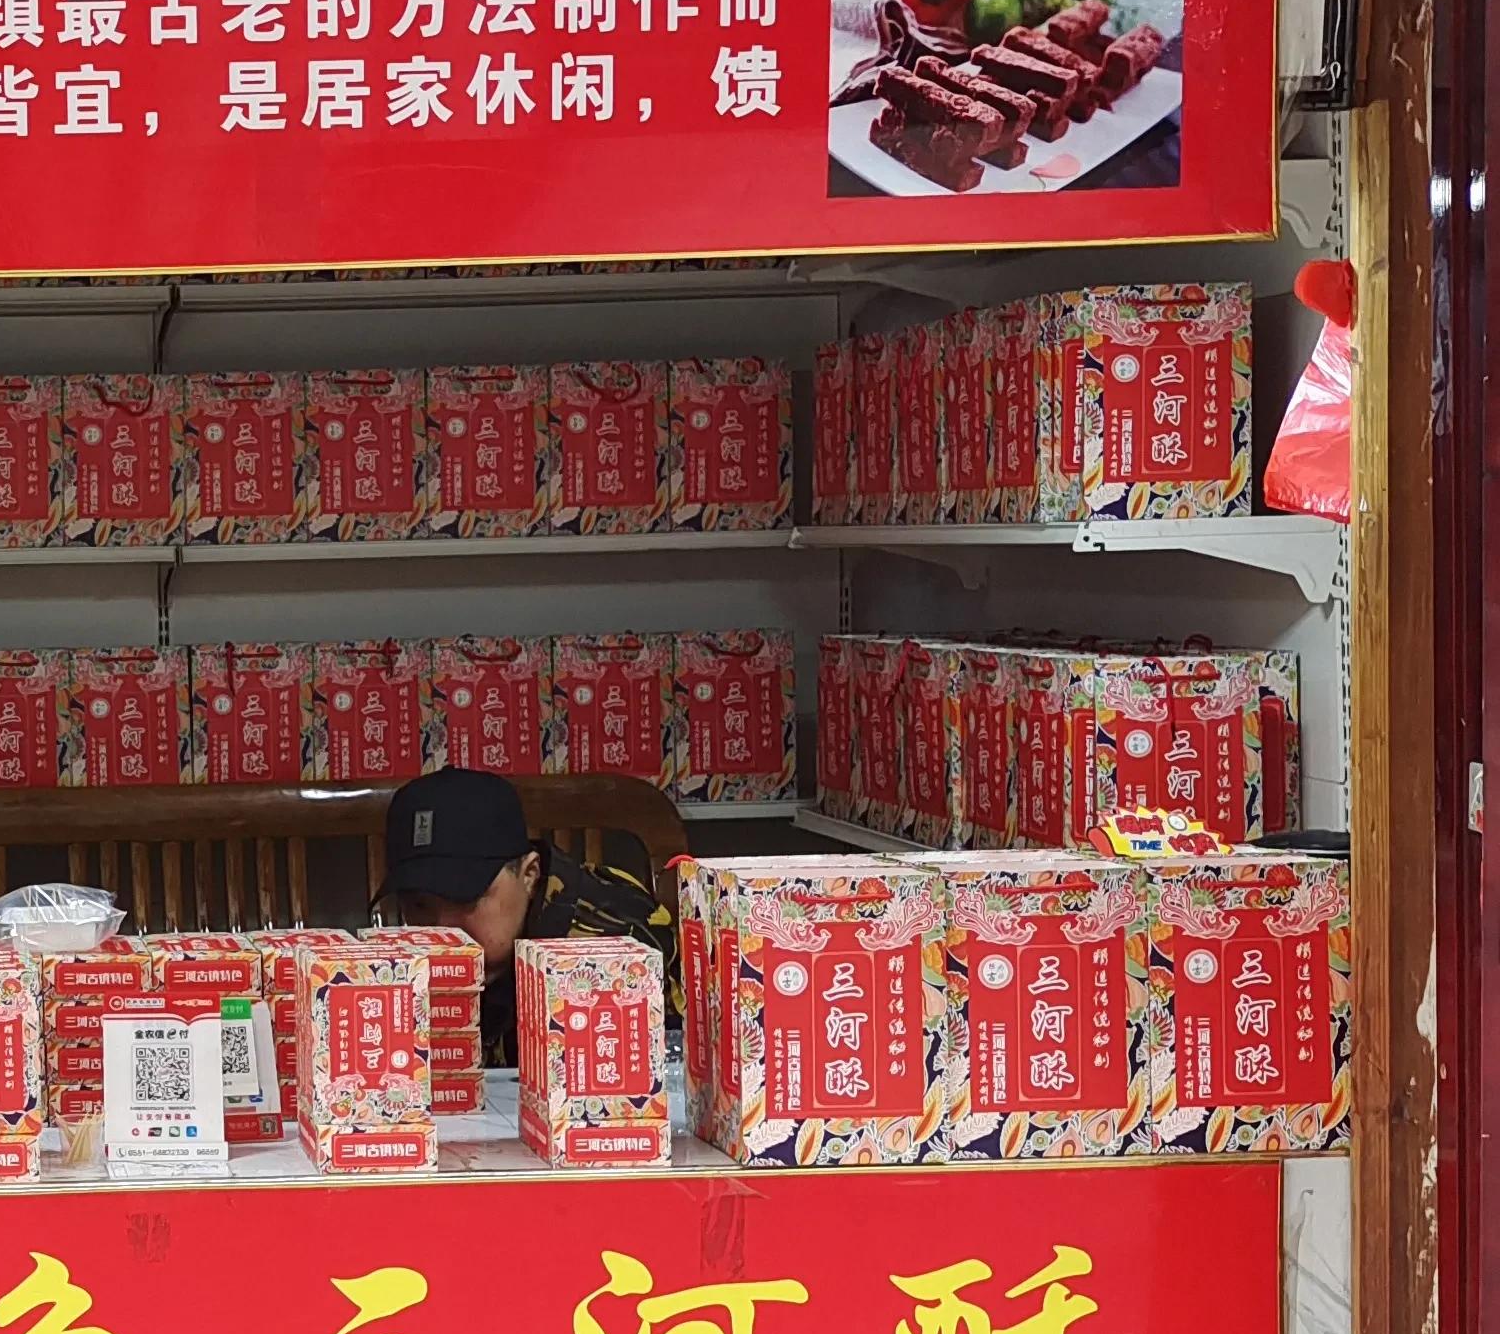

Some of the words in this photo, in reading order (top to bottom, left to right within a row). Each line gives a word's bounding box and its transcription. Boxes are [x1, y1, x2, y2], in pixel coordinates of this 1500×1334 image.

[1151, 355, 1187, 465] 三河酥
[1165, 730, 1199, 820] 三河
[823, 963, 869, 1097] 三河酥
[1028, 956, 1074, 1090] 三河酥
[1232, 950, 1279, 1084] 三河酥
